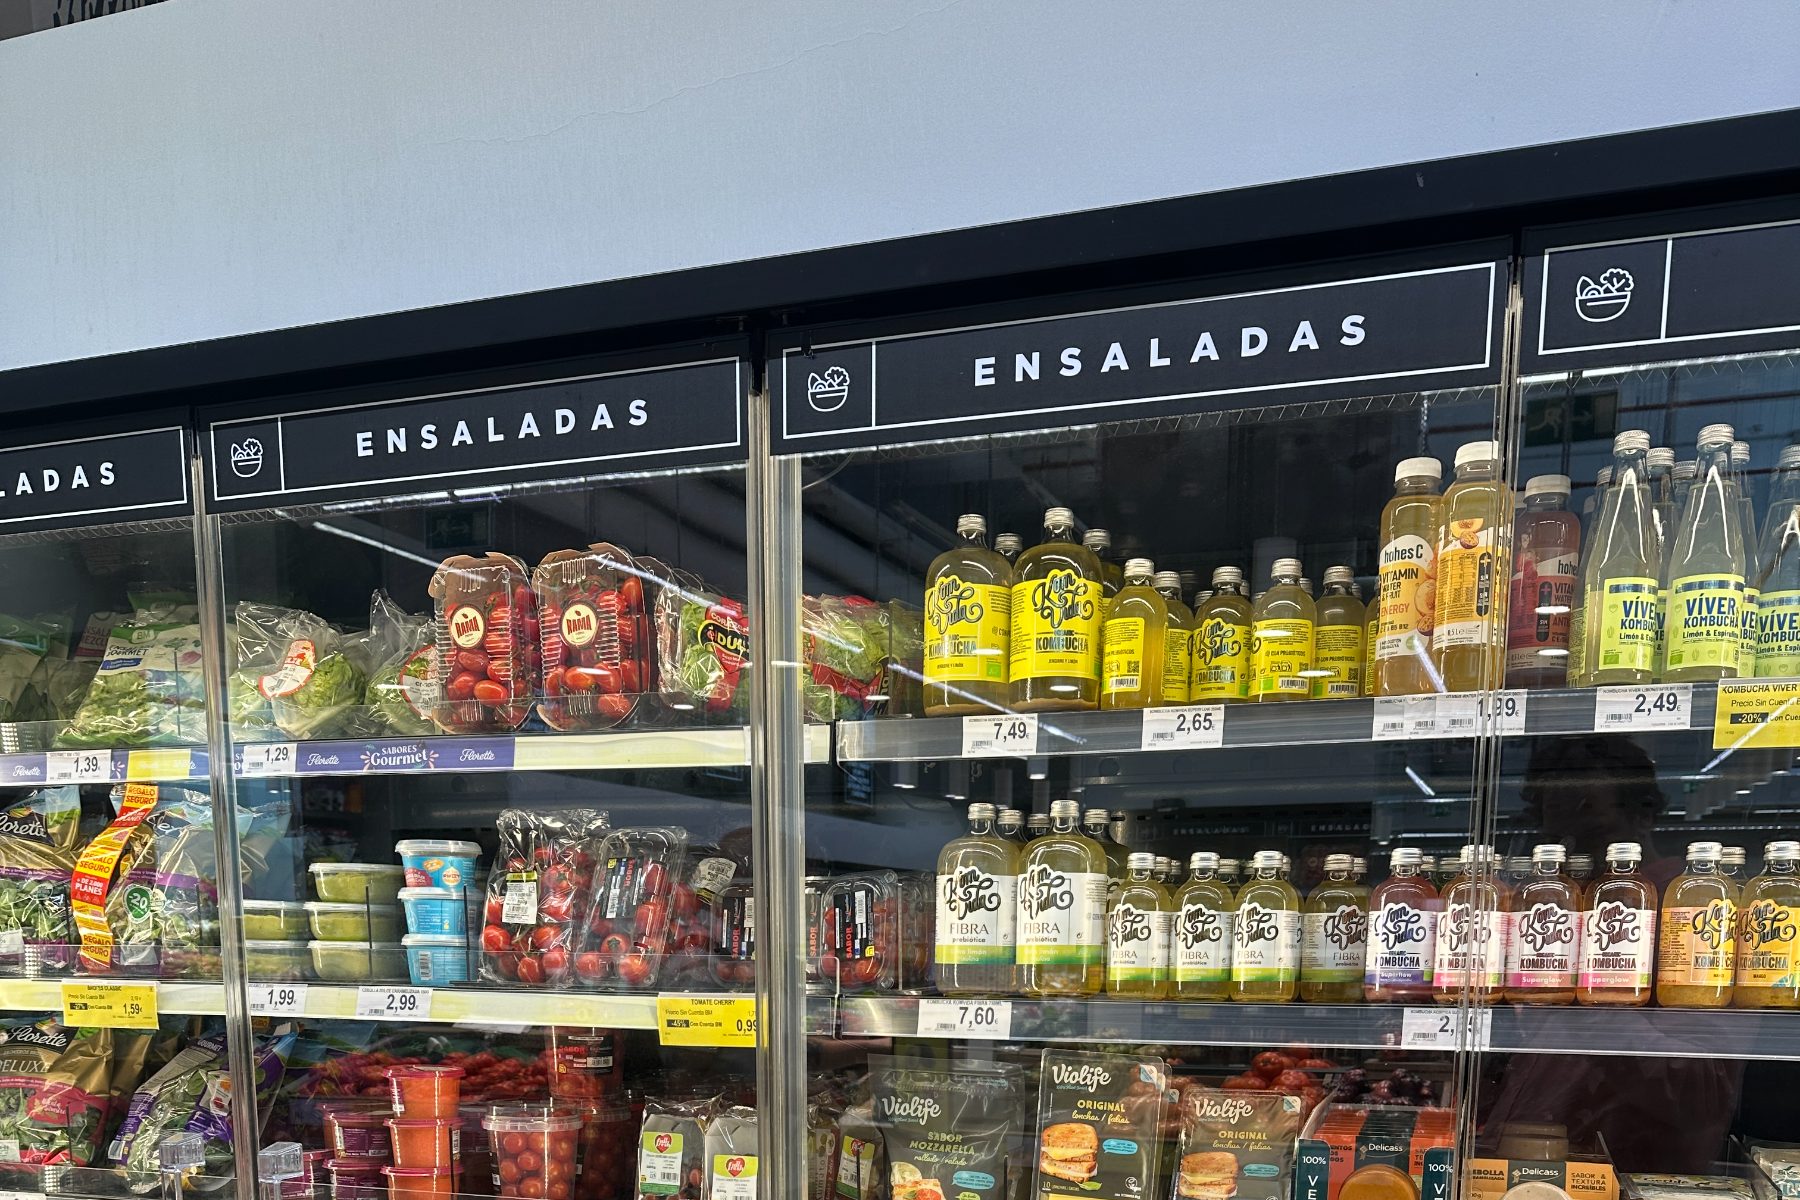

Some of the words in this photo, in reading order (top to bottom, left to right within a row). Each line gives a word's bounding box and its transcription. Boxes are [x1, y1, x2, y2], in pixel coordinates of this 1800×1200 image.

[973, 314, 1367, 387] ENSALADAS
[356, 400, 649, 458] ENSALADAS
[0, 462, 117, 497] ADAS
[1686, 593, 1737, 617] VÍVER
[455, 615, 481, 637] RAMA
[566, 614, 592, 637] RAMA
[1682, 629, 1704, 639] Limón
[1036, 637, 1089, 652] KOMBUCHA
[1723, 685, 1771, 694] KOMBUCHA
[1772, 684, 1798, 692] VIVER
[1731, 699, 1754, 707] Precio
[1755, 699, 1767, 707] Sin
[1738, 714, 1763, 723] -20%
[381, 744, 418, 755] SABORES
[460, 749, 495, 763] Florette
[371, 750, 428, 767] Gourmet
[79, 860, 111, 874] SEGURO
[75, 883, 103, 895] PLANES
[950, 922, 990, 935] FIBRA
[1023, 922, 1061, 935] FIBRA
[1333, 952, 1361, 961] FIBRA
[1519, 957, 1568, 970] KOMBUCHA
[1052, 1063, 1112, 1092] Violife
[882, 1097, 942, 1125] Violife
[1077, 1099, 1126, 1112] ORIGINAL
[1193, 1098, 1254, 1125] Violife
[927, 1131, 963, 1143] SABOR
[1218, 1130, 1268, 1141] ORIGINAL
[909, 1141, 975, 1156] MOZZARELLA
[1368, 1143, 1403, 1152] Delicass
[1302, 1156, 1327, 1165] 100%
[1428, 1163, 1454, 1173] 100%
[1521, 1167, 1559, 1177] Delicass
[1571, 1172, 1596, 1180] SABOR
[1571, 1179, 1606, 1187] TEXTURA
